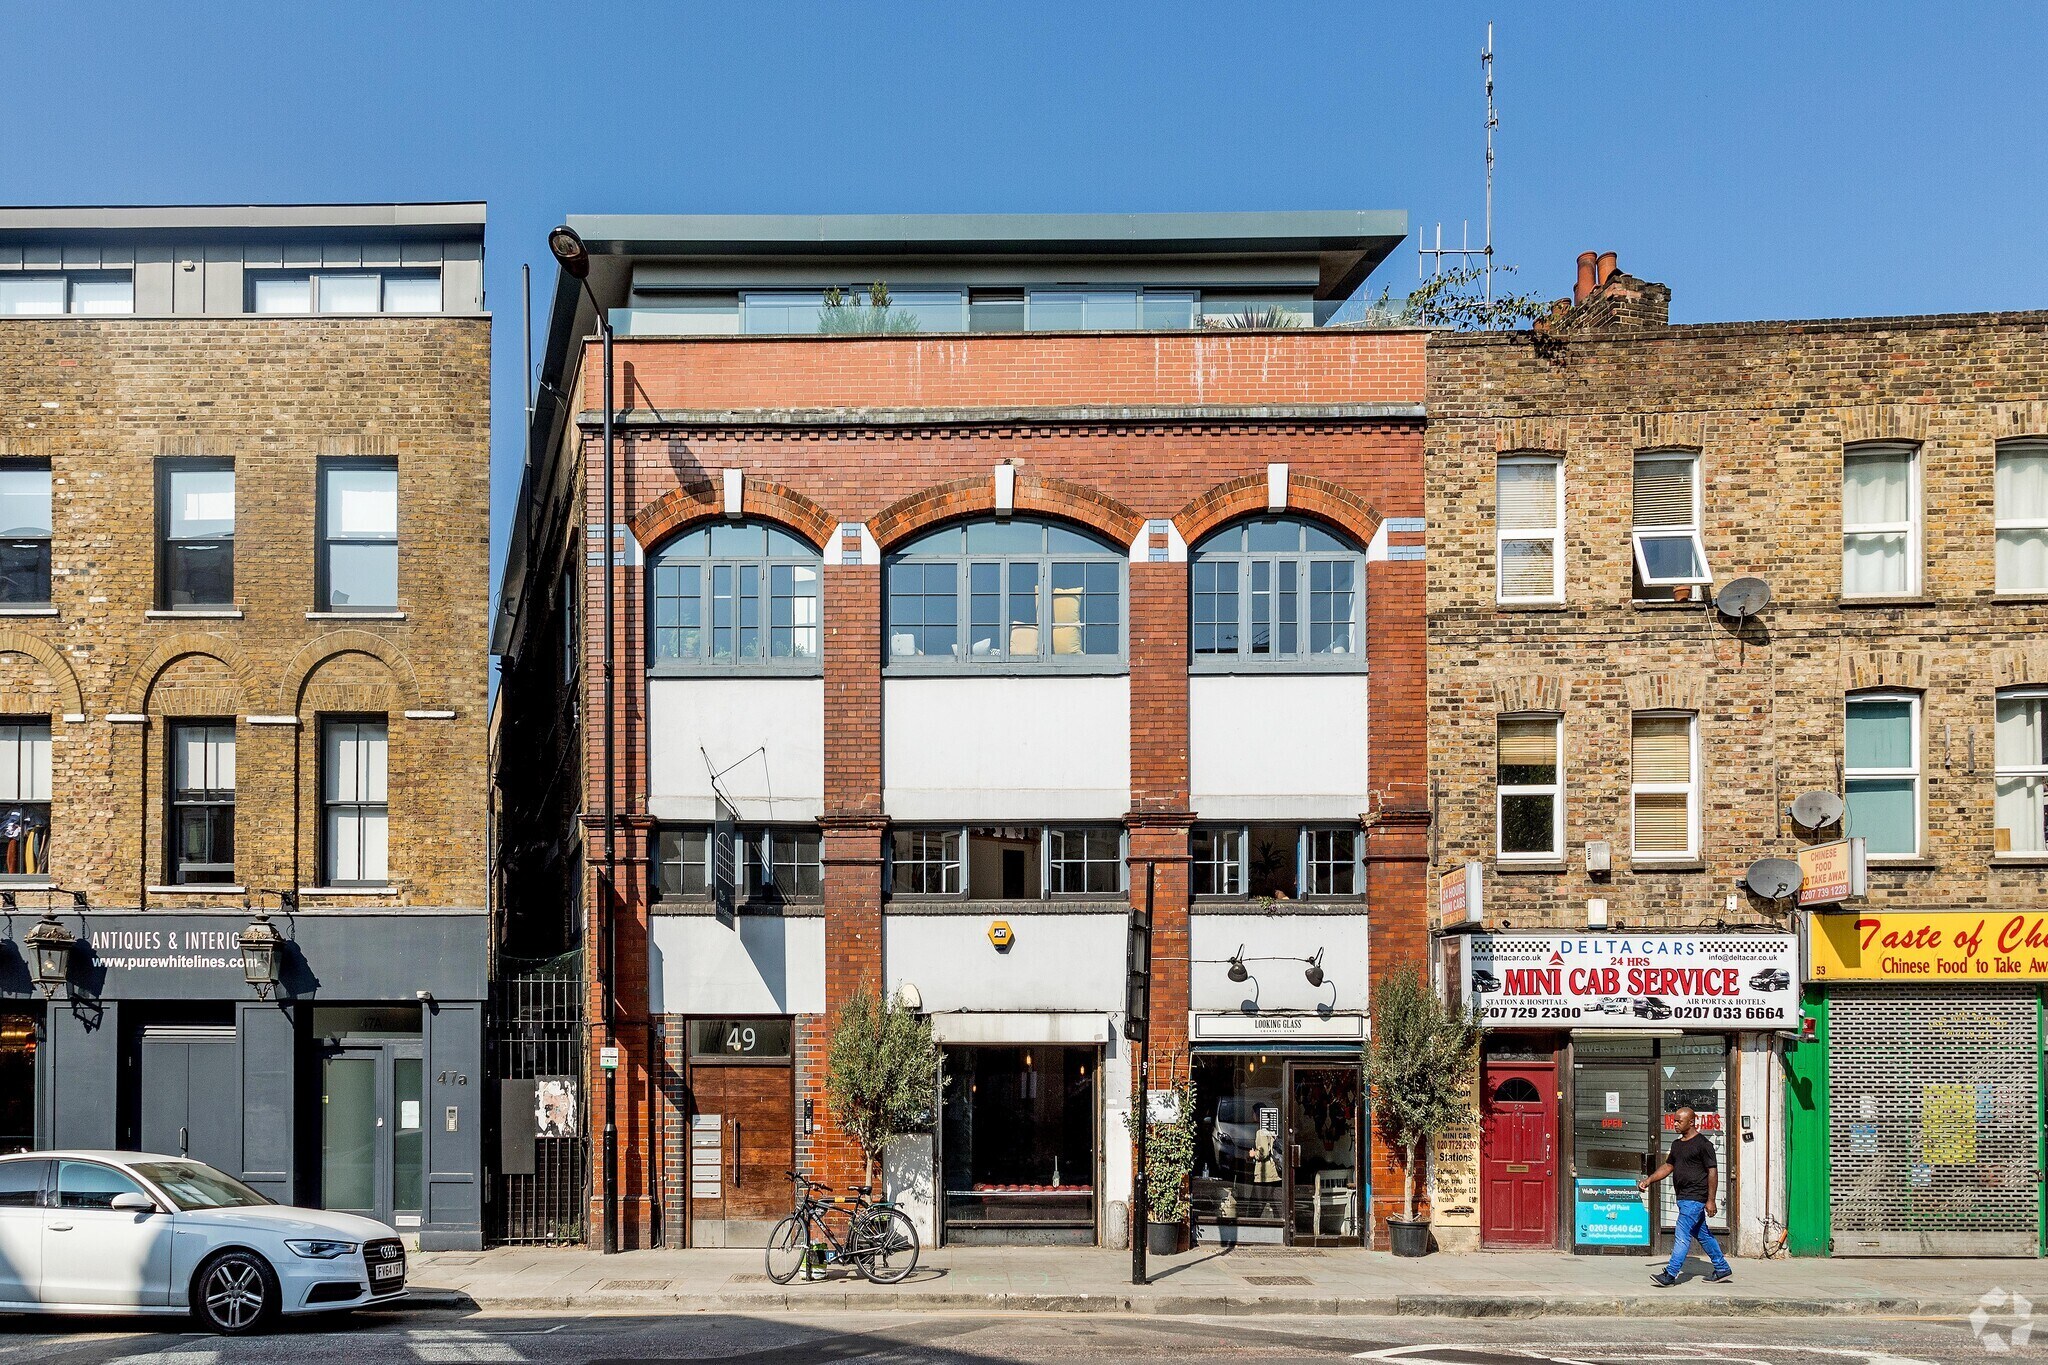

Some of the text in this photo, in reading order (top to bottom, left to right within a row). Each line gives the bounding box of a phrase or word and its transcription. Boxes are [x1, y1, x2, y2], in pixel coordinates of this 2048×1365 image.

[1810, 848, 1838, 861] CHINESE
[1815, 861, 1832, 872] FOOD
[1811, 874, 1827, 885] TAKE
[1828, 870, 1847, 880] AWAY
[1801, 884, 1847, 900] 0207 739 1228
[994, 929, 1007, 937] ADT
[1853, 919, 1942, 951] Taste
[1953, 919, 1985, 958] of
[91, 931, 161, 950] ANTIQUES
[168, 932, 178, 950] &
[1561, 940, 1695, 956] DELTA CARS
[91, 955, 258, 970] www.purewhitelines.com
[1471, 954, 1542, 962] www.deltacar.co.uk
[1610, 957, 1650, 967] 24 HRS
[1708, 954, 1778, 962] info@deltacar.co.uk
[1815, 966, 1826, 976] 53
[1882, 957, 2048, 974] Chinese Food to Take Aw
[1503, 968, 1740, 996] MINI CAB SERVICE
[1485, 999, 1518, 1007] STATION
[1686, 998, 1700, 1006] AIR
[1701, 998, 1726, 1006] PORTS
[1735, 998, 1767, 1006] HOTELS
[1474, 1007, 1581, 1018] 207 729 2300
[1674, 1007, 1785, 1019] 0207 033 6664
[1254, 1019, 1302, 1029] LOOKING GLASS
[726, 1027, 756, 1051] 49
[437, 1069, 468, 1087] 47a
[1601, 1118, 1623, 1129] OPEN
[1439, 1152, 1473, 1162] Stations
[1593, 1203, 1630, 1212] Drop Off Point
[1588, 1224, 1643, 1233] 0203 6640 642
